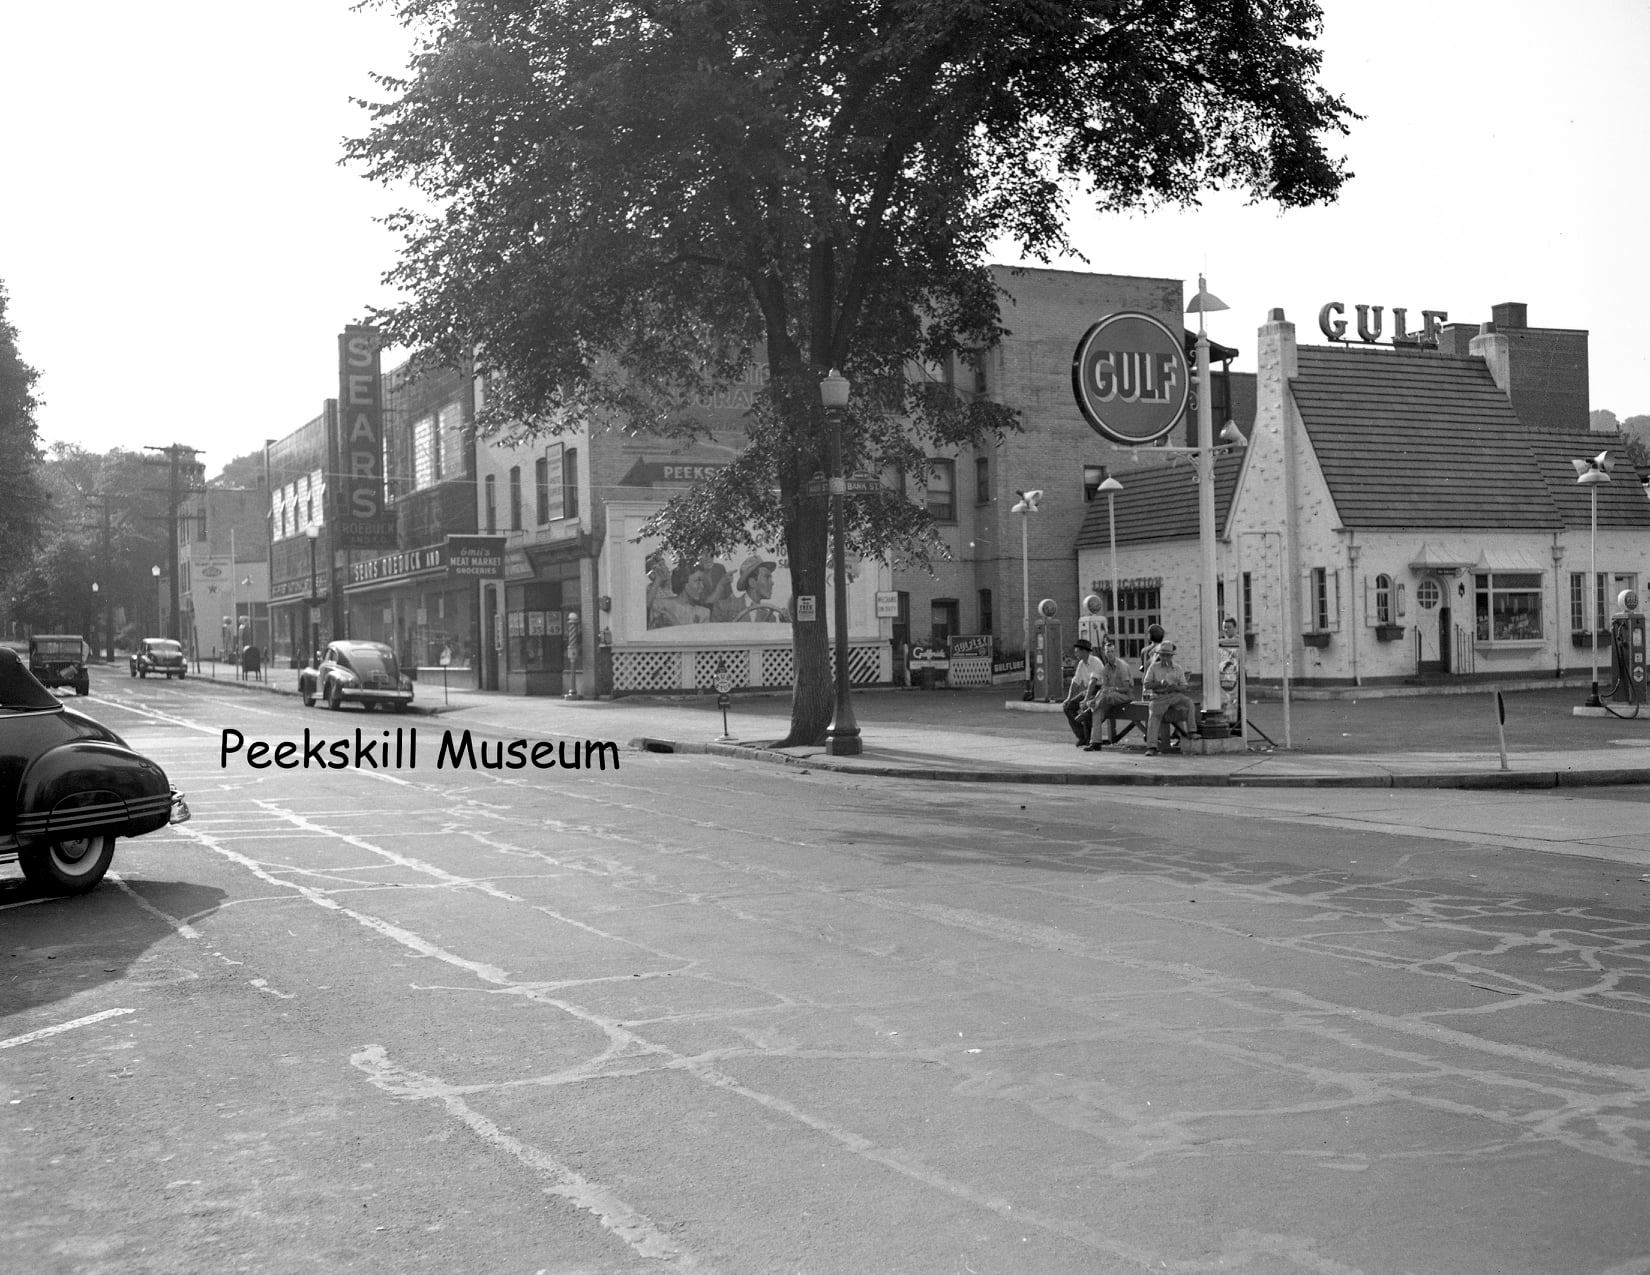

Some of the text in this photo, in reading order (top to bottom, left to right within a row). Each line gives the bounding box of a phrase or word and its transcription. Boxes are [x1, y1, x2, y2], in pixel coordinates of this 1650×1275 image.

[1319, 302, 1448, 345] GULF
[1088, 350, 1177, 403] GULF
[348, 337, 377, 518] SEARS
[847, 482, 867, 491] BANK
[342, 522, 394, 535] ROEBUCK
[354, 561, 378, 582] SEARS
[382, 552, 421, 576] ROEBUCK
[450, 557, 501, 567] MEAT MARKET
[456, 567, 496, 575] GROCERIES
[1092, 576, 1163, 591] LUBICATION
[994, 660, 1025, 673] GULFLUBE
